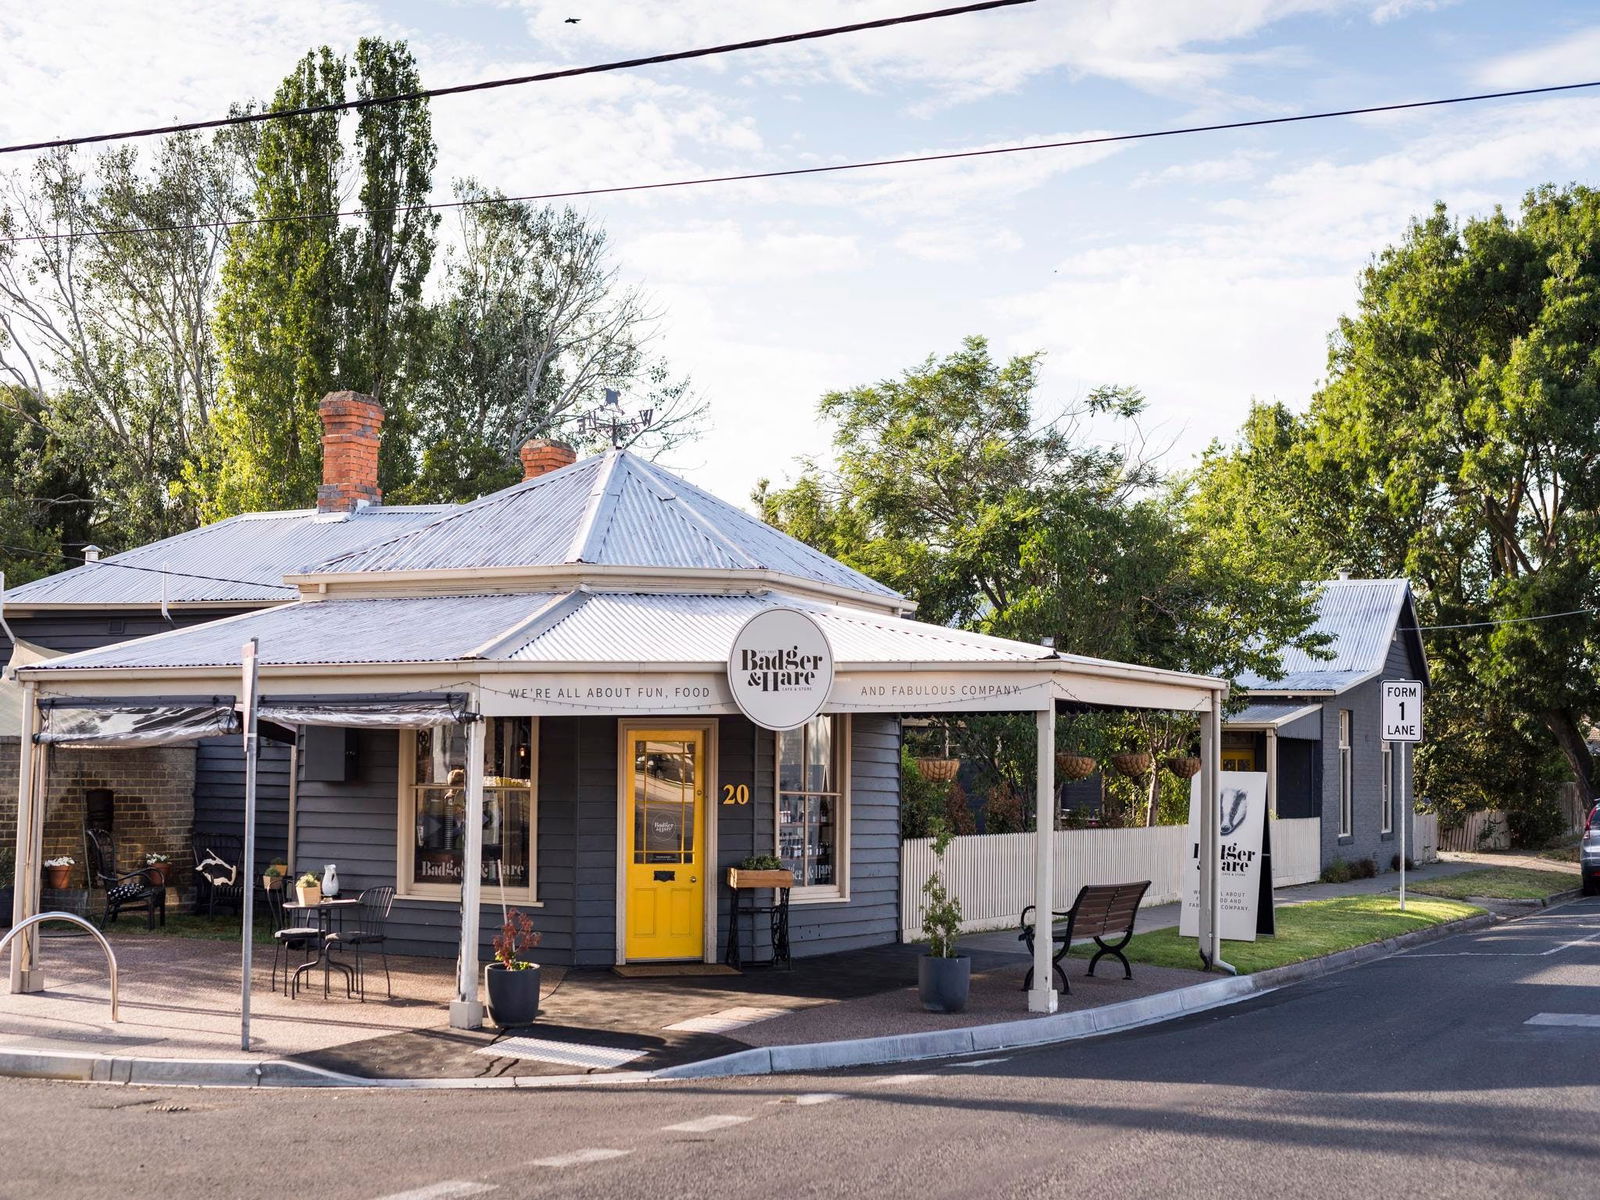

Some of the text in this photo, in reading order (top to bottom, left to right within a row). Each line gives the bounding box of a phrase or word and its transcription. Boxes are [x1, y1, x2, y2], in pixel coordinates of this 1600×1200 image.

[741, 645, 823, 671] Badger
[509, 687, 710, 699] WE'RE ALL ABOUT FUN, FOOD
[860, 685, 1022, 696] AND FABULOUS COMPANY.
[1387, 687, 1417, 697] FORM
[1398, 702, 1405, 720] 1
[1387, 725, 1416, 735] LANE
[723, 784, 749, 805] 20
